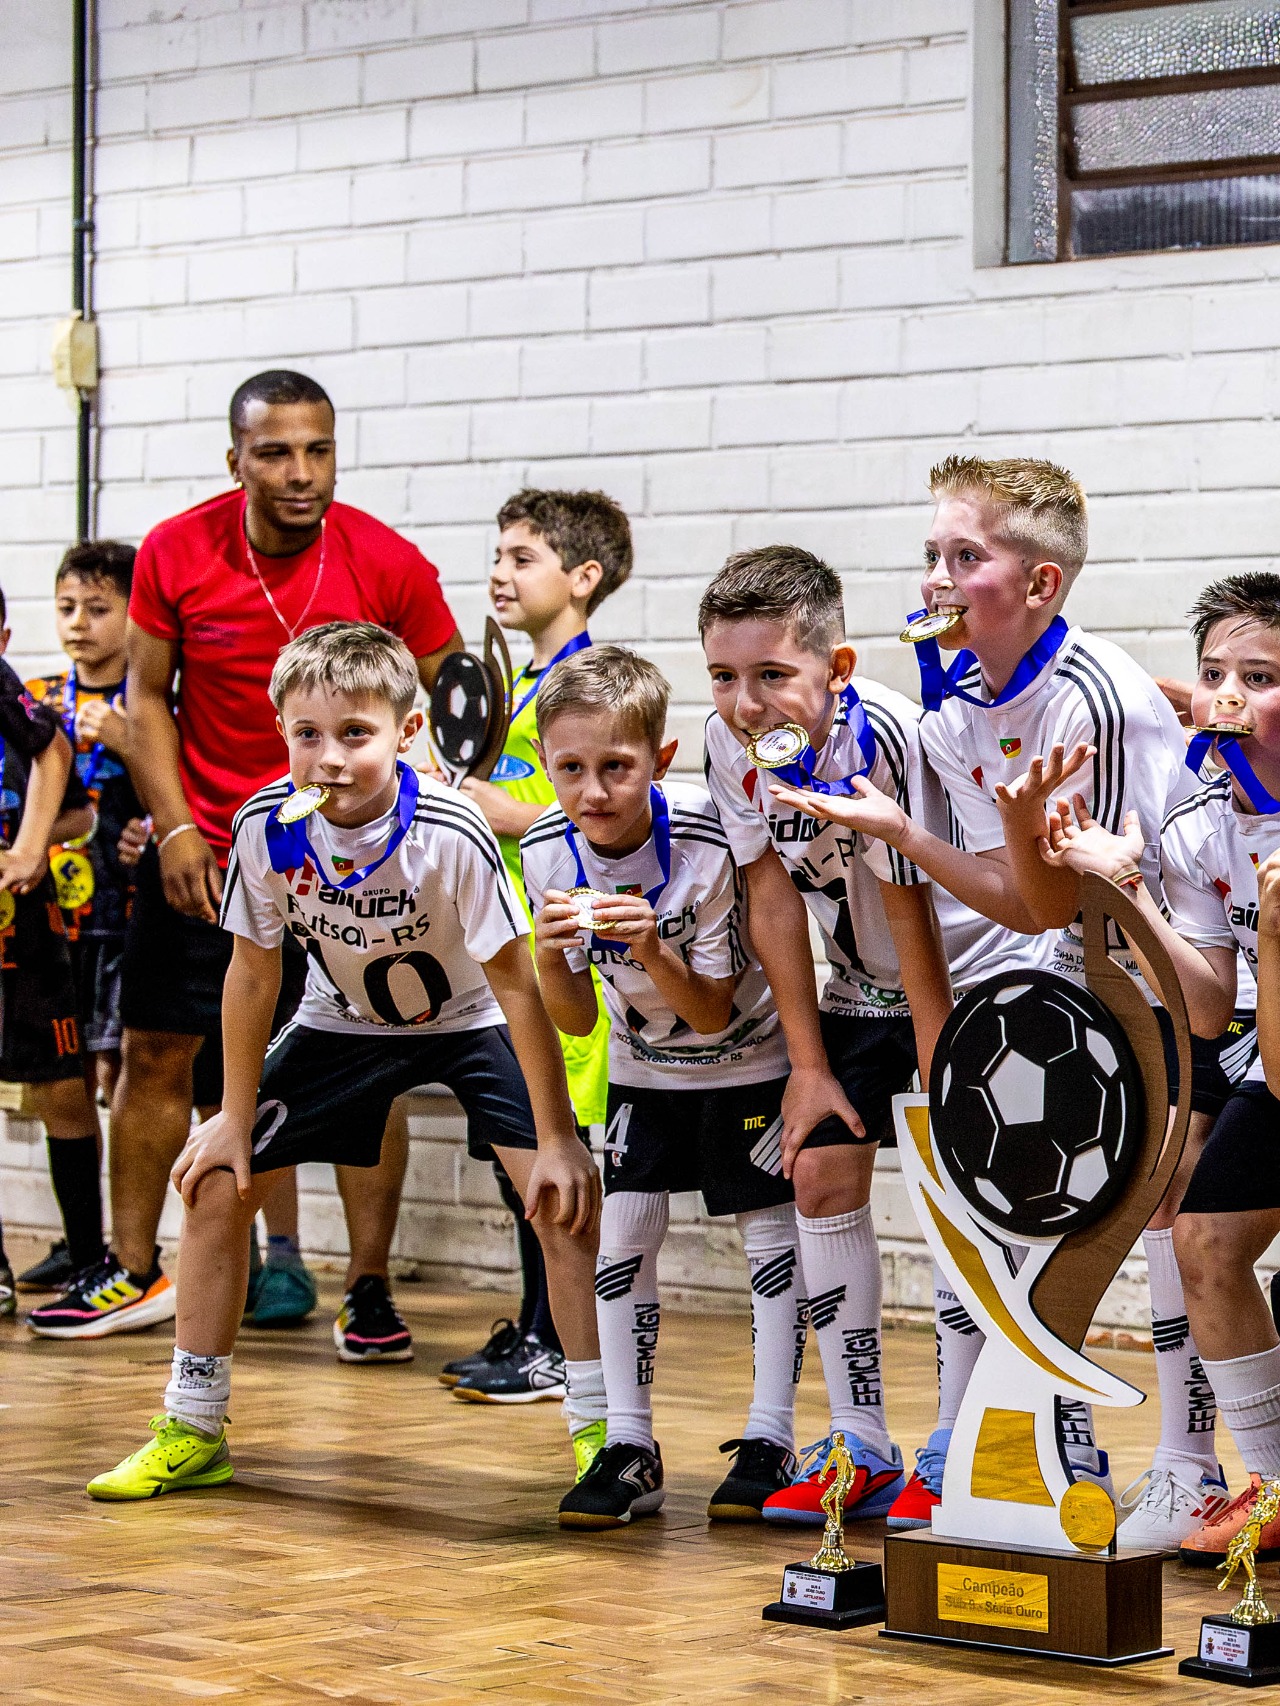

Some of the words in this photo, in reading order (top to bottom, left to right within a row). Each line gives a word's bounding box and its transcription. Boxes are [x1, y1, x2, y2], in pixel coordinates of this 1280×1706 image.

[362, 887, 391, 897] GRUPO
[391, 913, 431, 947] RS
[52, 1017, 79, 1056] 10
[962, 1577, 1025, 1598] Campeão
[1015, 1604, 1043, 1619] Ouro
